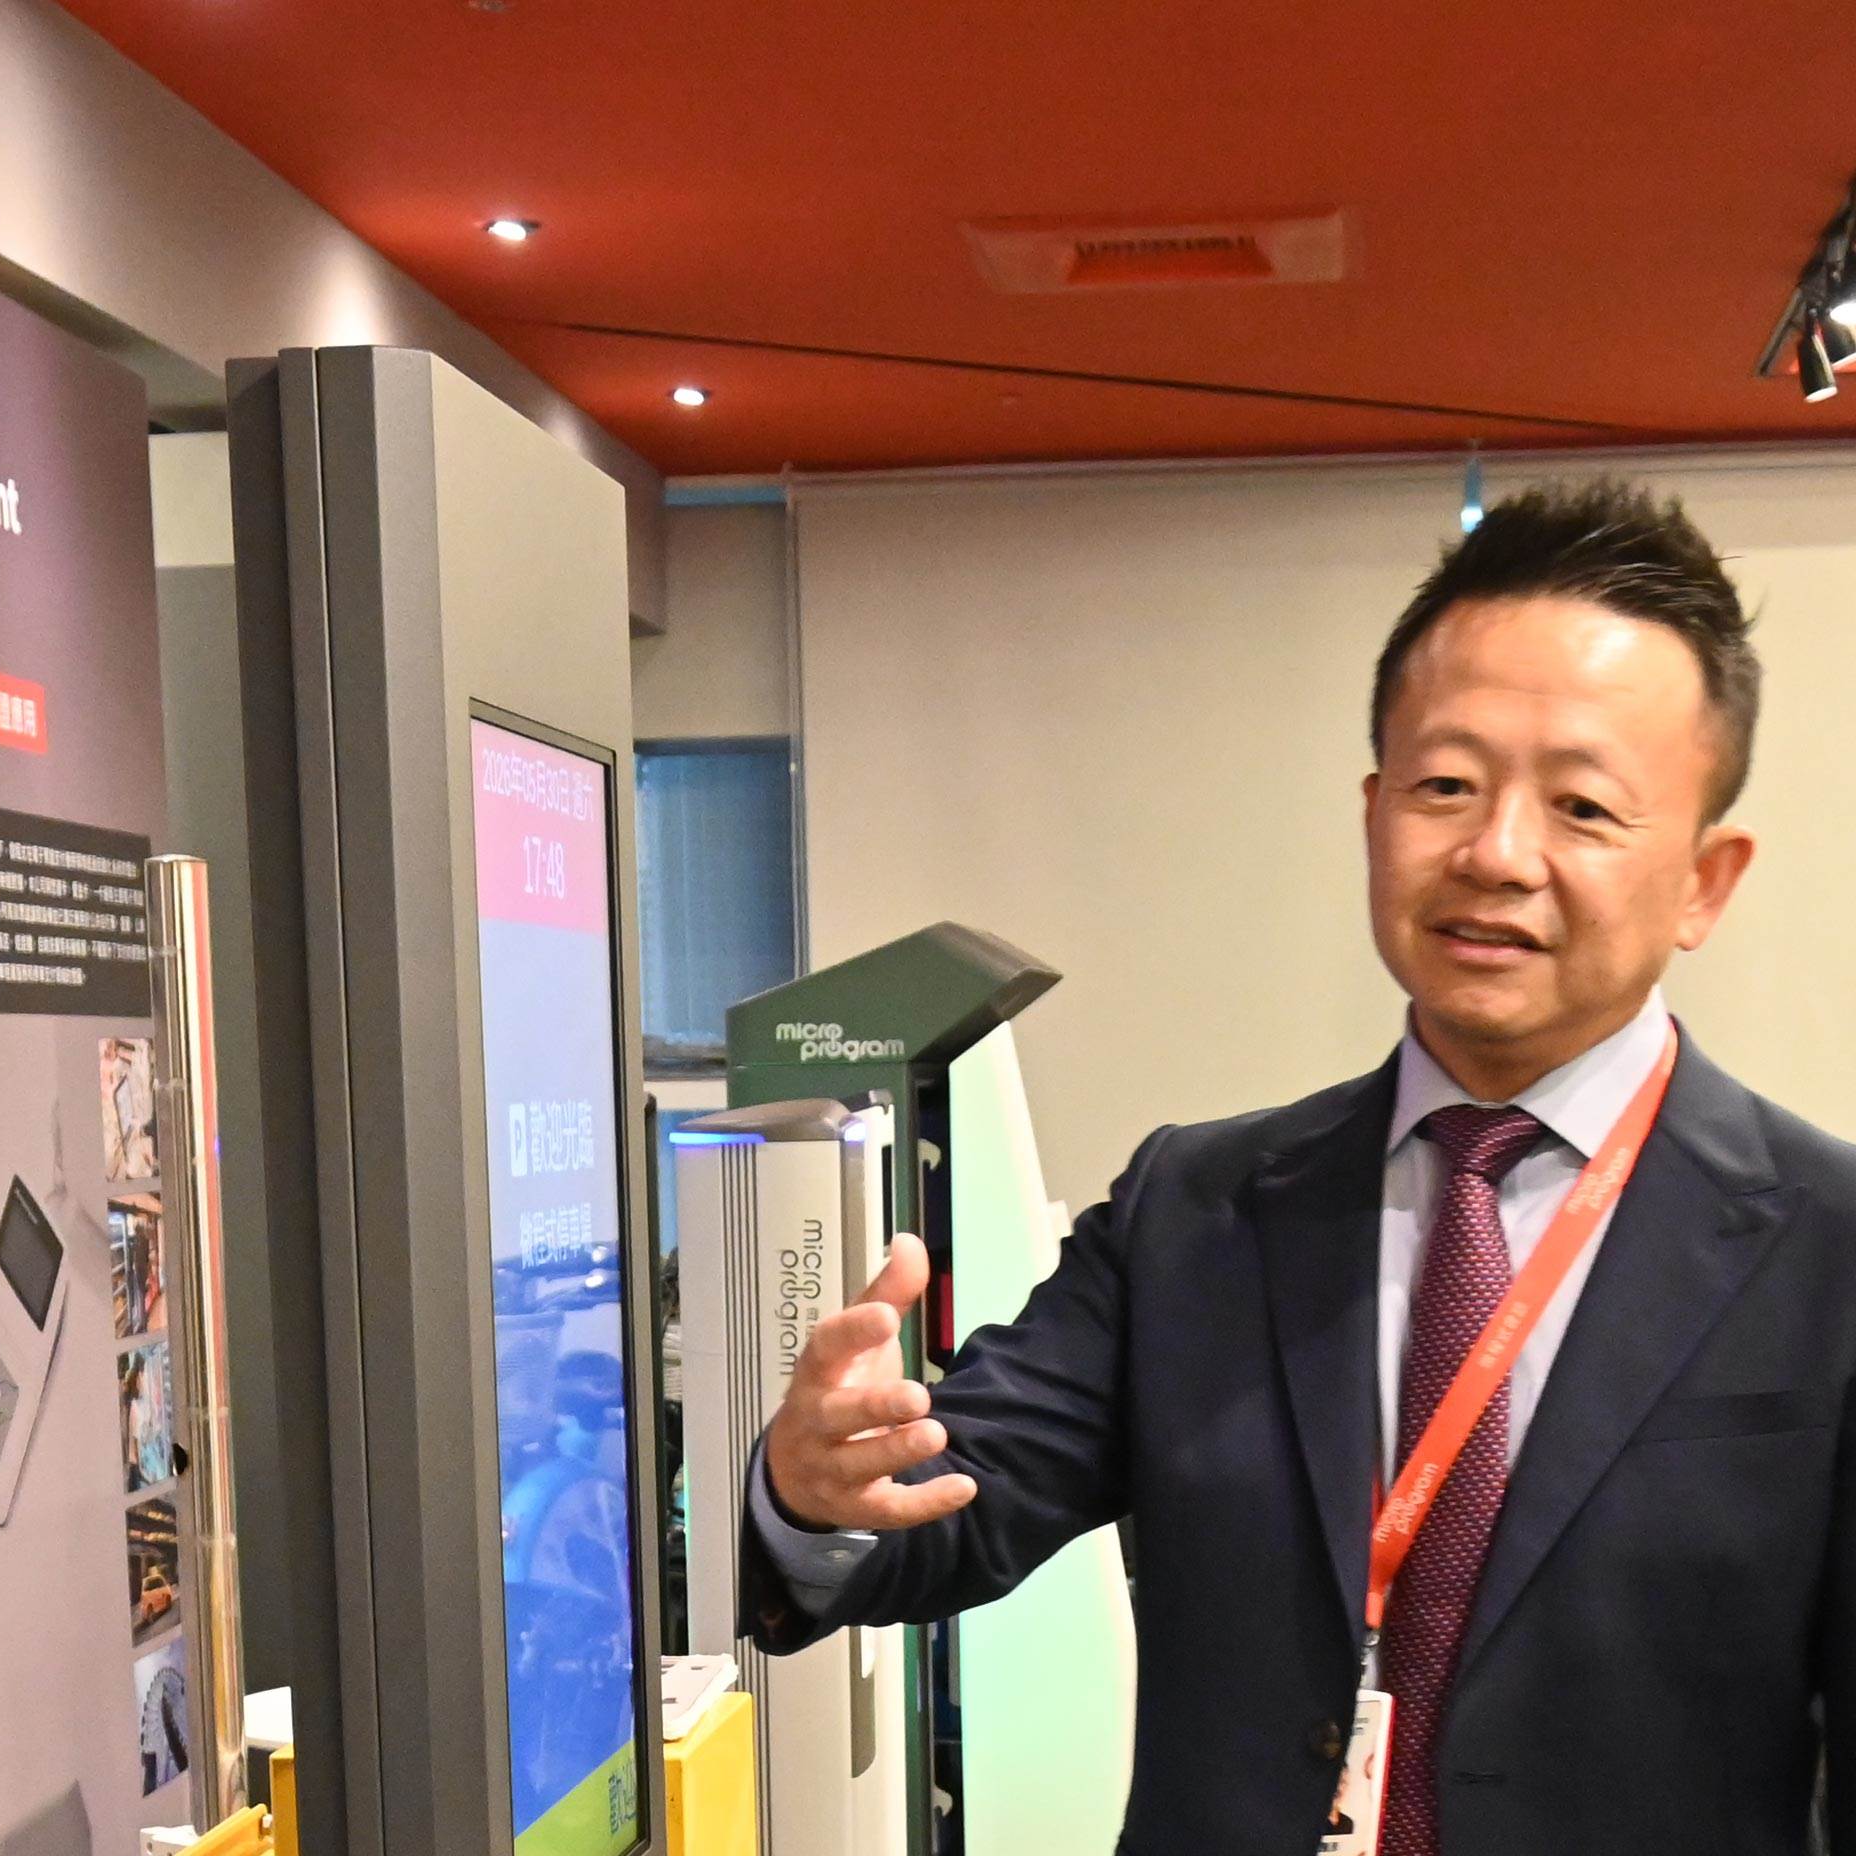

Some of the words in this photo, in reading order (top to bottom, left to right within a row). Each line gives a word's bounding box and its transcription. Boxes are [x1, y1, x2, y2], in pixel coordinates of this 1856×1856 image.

[523, 836, 565, 899] 17:48
[775, 1022, 843, 1041] micro
[800, 1039, 904, 1062] program
[802, 1219, 823, 1300] micro
